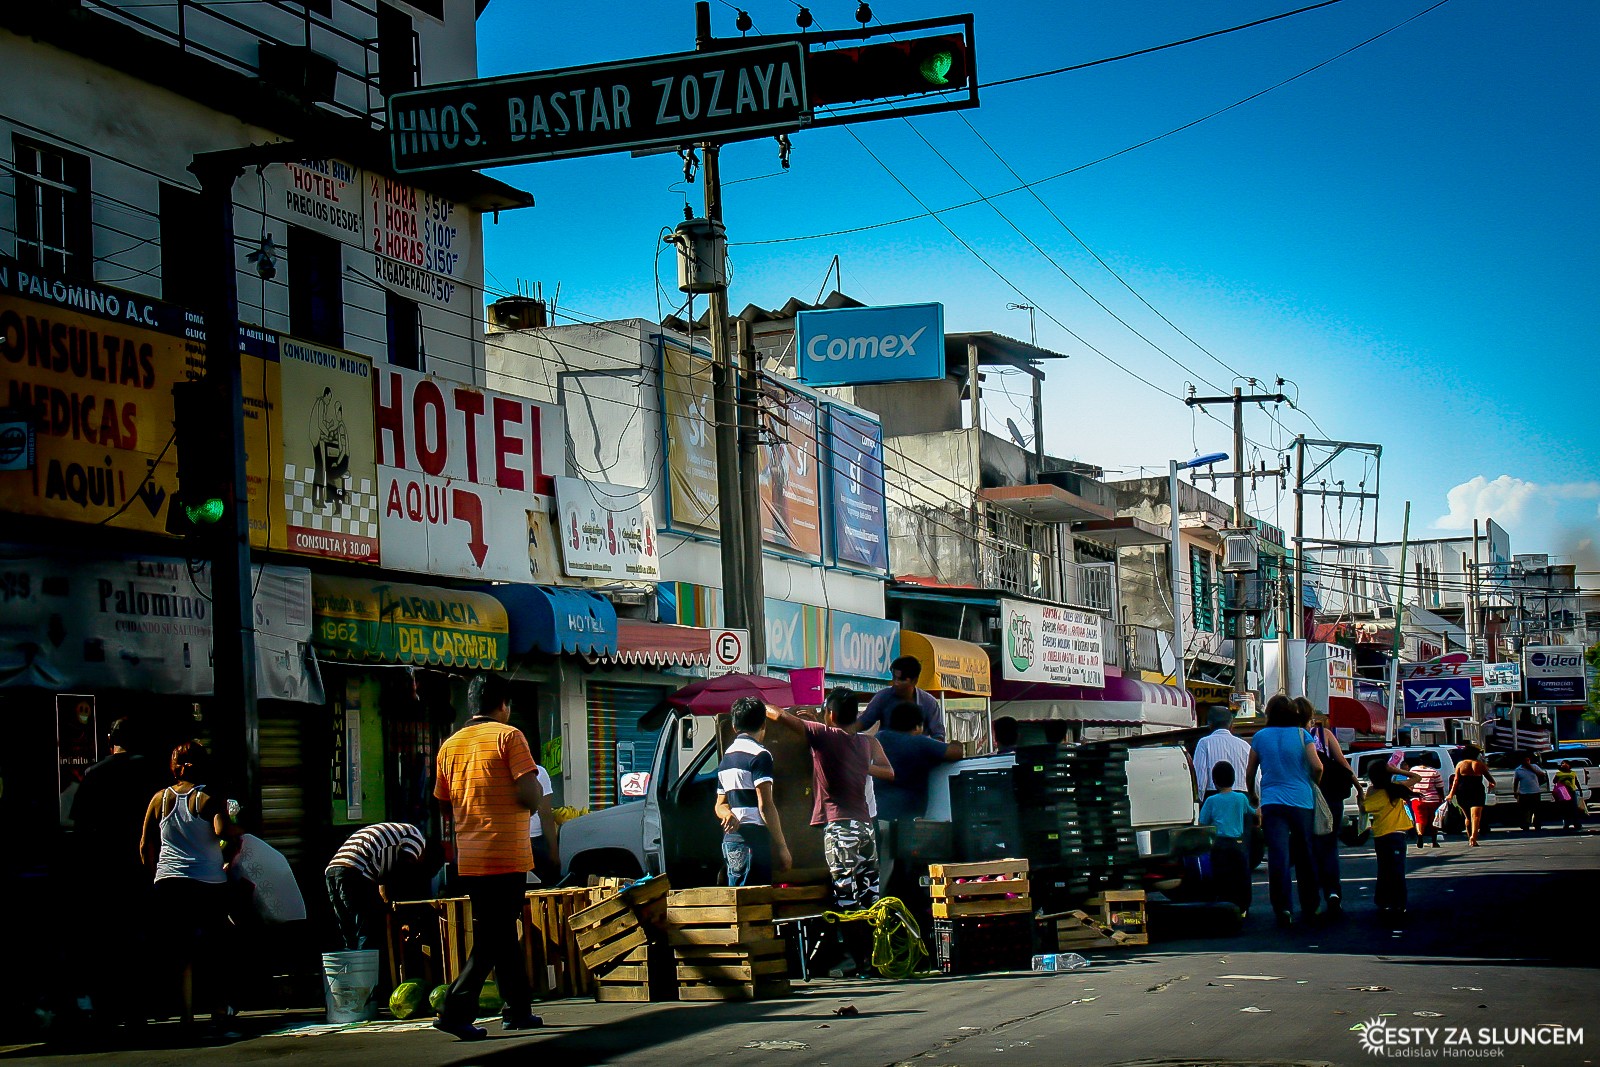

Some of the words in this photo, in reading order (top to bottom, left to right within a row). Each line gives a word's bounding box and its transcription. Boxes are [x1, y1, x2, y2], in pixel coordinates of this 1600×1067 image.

[400, 103, 487, 156] HNOS.
[509, 84, 632, 141] BASTAR
[651, 62, 800, 125] ZOZAYA
[287, 190, 328, 222] PRECIOS
[384, 178, 418, 213] HORA
[373, 201, 379, 225] 1
[385, 204, 418, 239] HORA
[374, 227, 383, 253] 2
[386, 231, 424, 266] HORAS
[375, 255, 431, 295] REGADERAZO
[126, 299, 159, 326] A.C.
[283, 342, 337, 370] CONSULTORIO
[339, 358, 368, 378] MEDICO
[807, 325, 927, 362] Comex
[8, 380, 137, 451] MEDICAS
[373, 366, 555, 498] HOTEL
[387, 478, 452, 526] AQUÍ
[296, 532, 340, 552] CONSULTA
[350, 542, 371, 557] 30.00
[98, 579, 205, 619] Palomino
[115, 620, 160, 636] CUIDANDO
[321, 621, 358, 643] 1962
[568, 613, 605, 633] HOTEL
[399, 626, 429, 656] DEL
[433, 630, 498, 661] CARMEN
[723, 638, 734, 659] E
[840, 622, 897, 674] Comex
[1013, 636, 1034, 668] Mag
